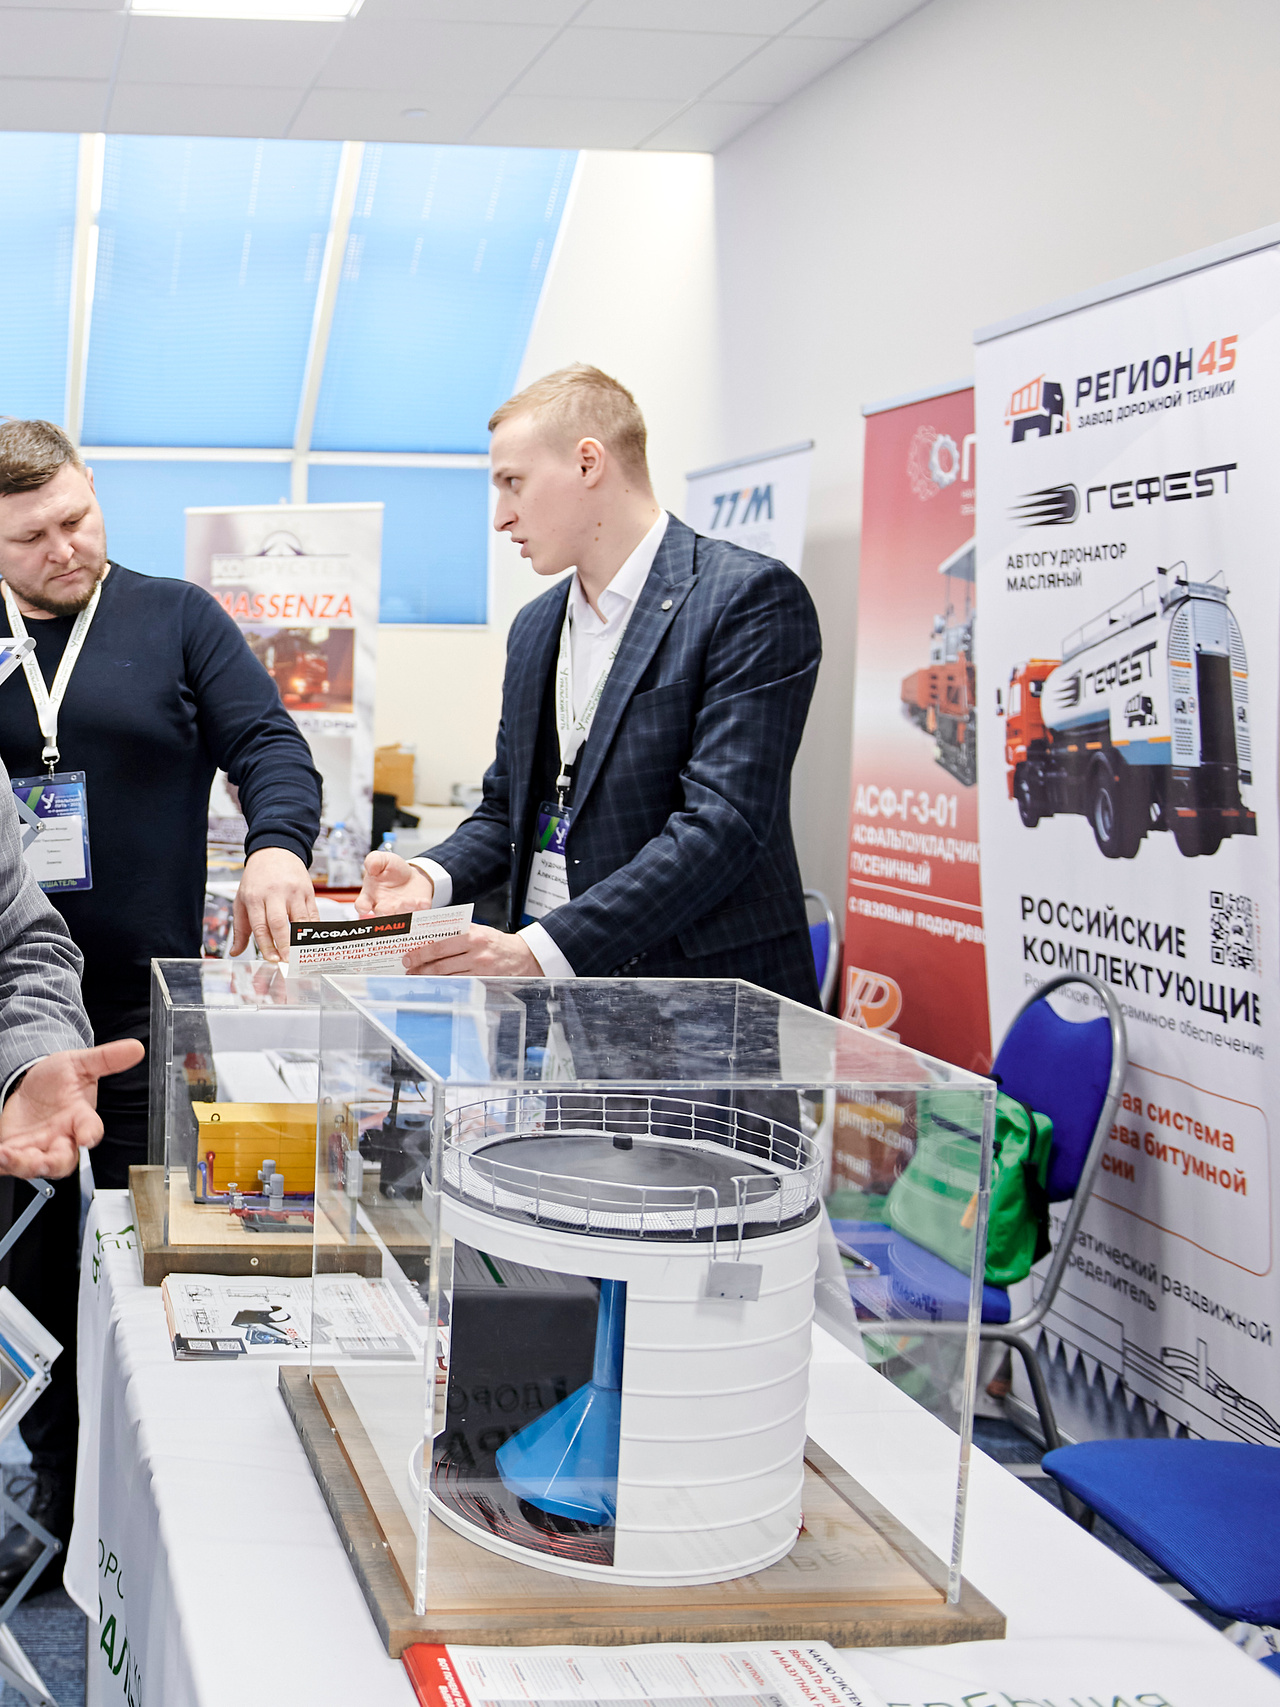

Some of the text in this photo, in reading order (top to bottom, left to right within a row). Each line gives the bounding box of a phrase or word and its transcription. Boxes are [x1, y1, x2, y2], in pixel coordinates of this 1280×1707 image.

[1077, 379, 1236, 429] ЗАВОД ДОРОЖНОЙ ТЕХНИКИ
[1006, 542, 1128, 571] АВТОГУДРОНАТОР
[1006, 568, 1083, 593] МАСЛЯНЫЙ
[41, 880, 78, 888] УШАТЕЛЬ
[850, 850, 931, 887] ГУСЕНИЧНЫЙ
[311, 921, 406, 939] АСФАЛЬТ МАШ
[859, 899, 914, 927] газовым
[1020, 894, 1187, 959] РОССИЙСКИЕ
[299, 929, 462, 954] ПРЕДСТАВЛЯЕМ ИННОВАЦИОННЫЕ
[299, 939, 435, 959] НАГРЕВАТЕЛИ ТЕРМАЛЬНОГО
[299, 956, 332, 964] МАСЛА
[1022, 935, 1262, 1028] КОМПЛЕКТУЮЩИЕ
[1121, 1092, 1235, 1153] ая система
[1101, 1152, 1135, 1183] сии
[1109, 1124, 1247, 1197] ева битумной
[1161, 1271, 1273, 1348] раздвижной
[776, 1656, 820, 1702] МАЗУТНЫХ
[787, 1648, 841, 1705] ВЫБРАТЬ ДЛЯ
[806, 1648, 865, 1707] КАКУЮ СИСТЕМ
